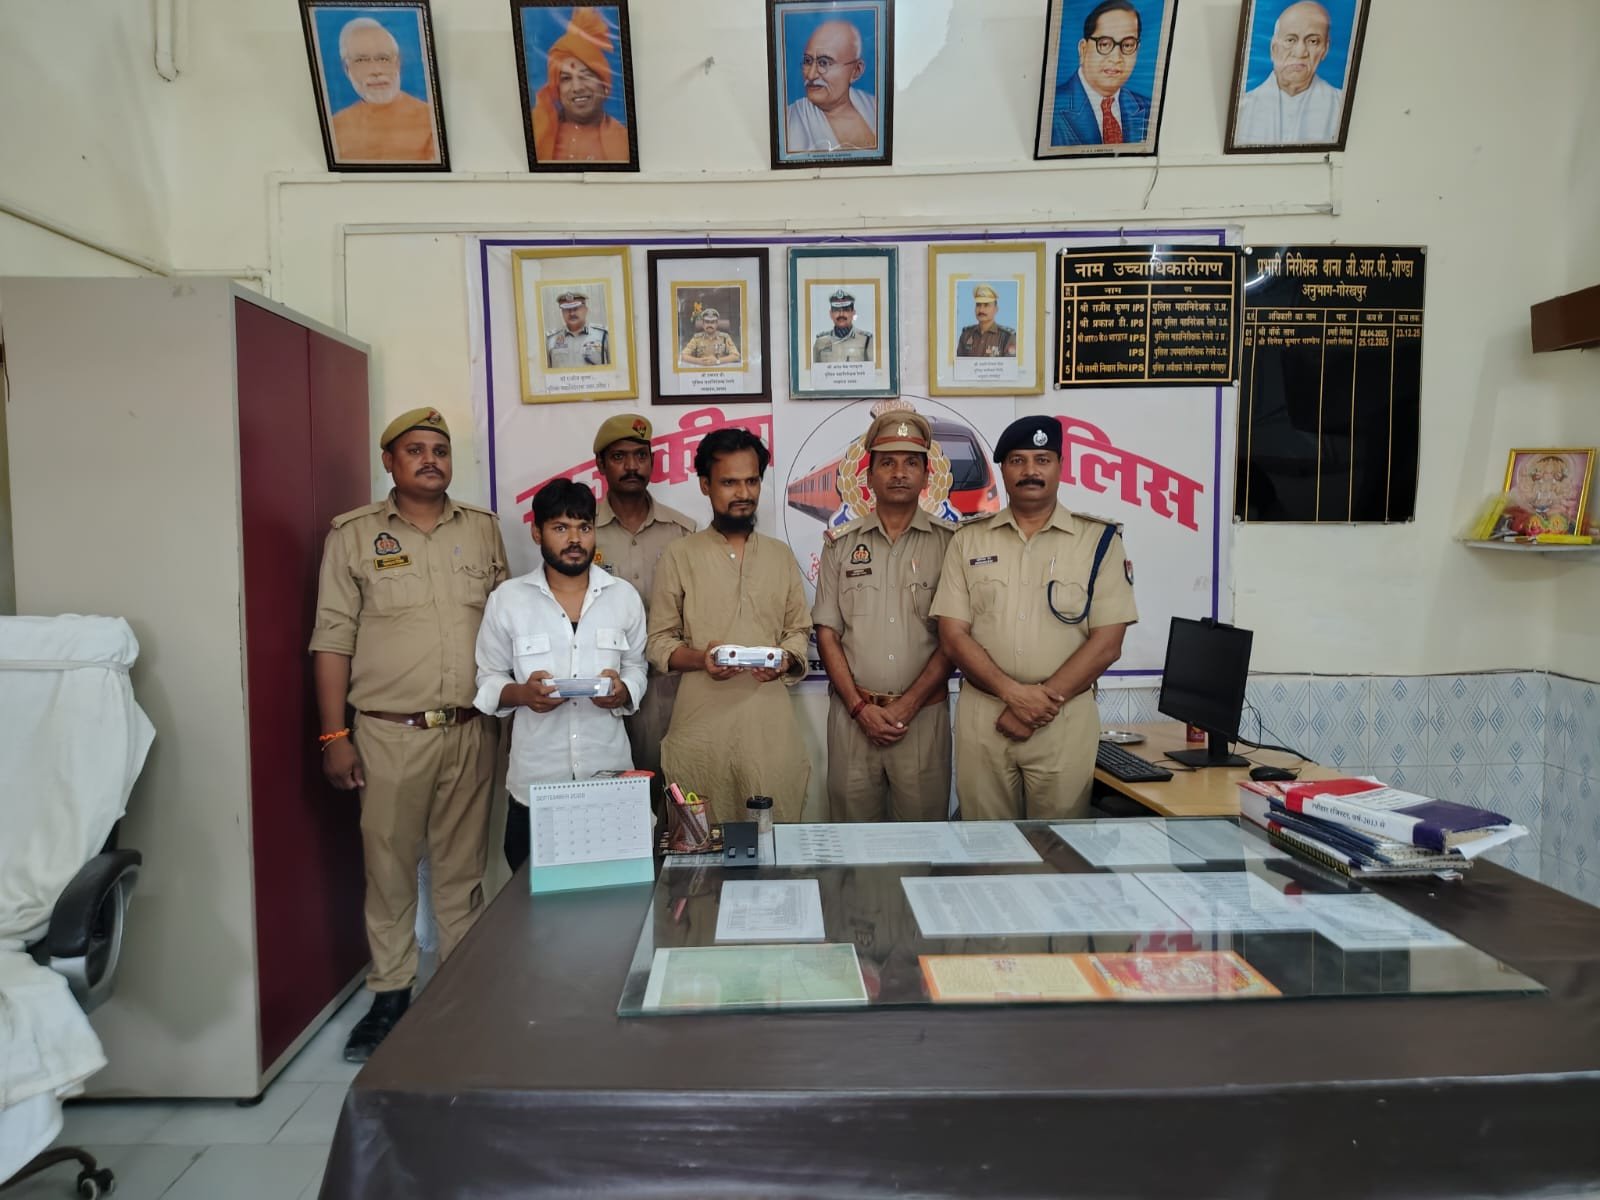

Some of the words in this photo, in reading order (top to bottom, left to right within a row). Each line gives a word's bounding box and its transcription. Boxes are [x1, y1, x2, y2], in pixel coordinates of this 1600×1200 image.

[1074, 262, 1104, 277] नाम
[1113, 256, 1223, 277] उच्चाधिकारीगण
[1257, 252, 1281, 278] प्रभारी
[1286, 252, 1318, 278] निरीक्षक
[1132, 303, 1144, 312] IPS
[1152, 300, 1172, 314] पुलिस
[1130, 318, 1144, 328] IPS
[1129, 334, 1146, 342] IPS
[1128, 348, 1144, 357] IPS
[1129, 364, 1144, 372] IPS
